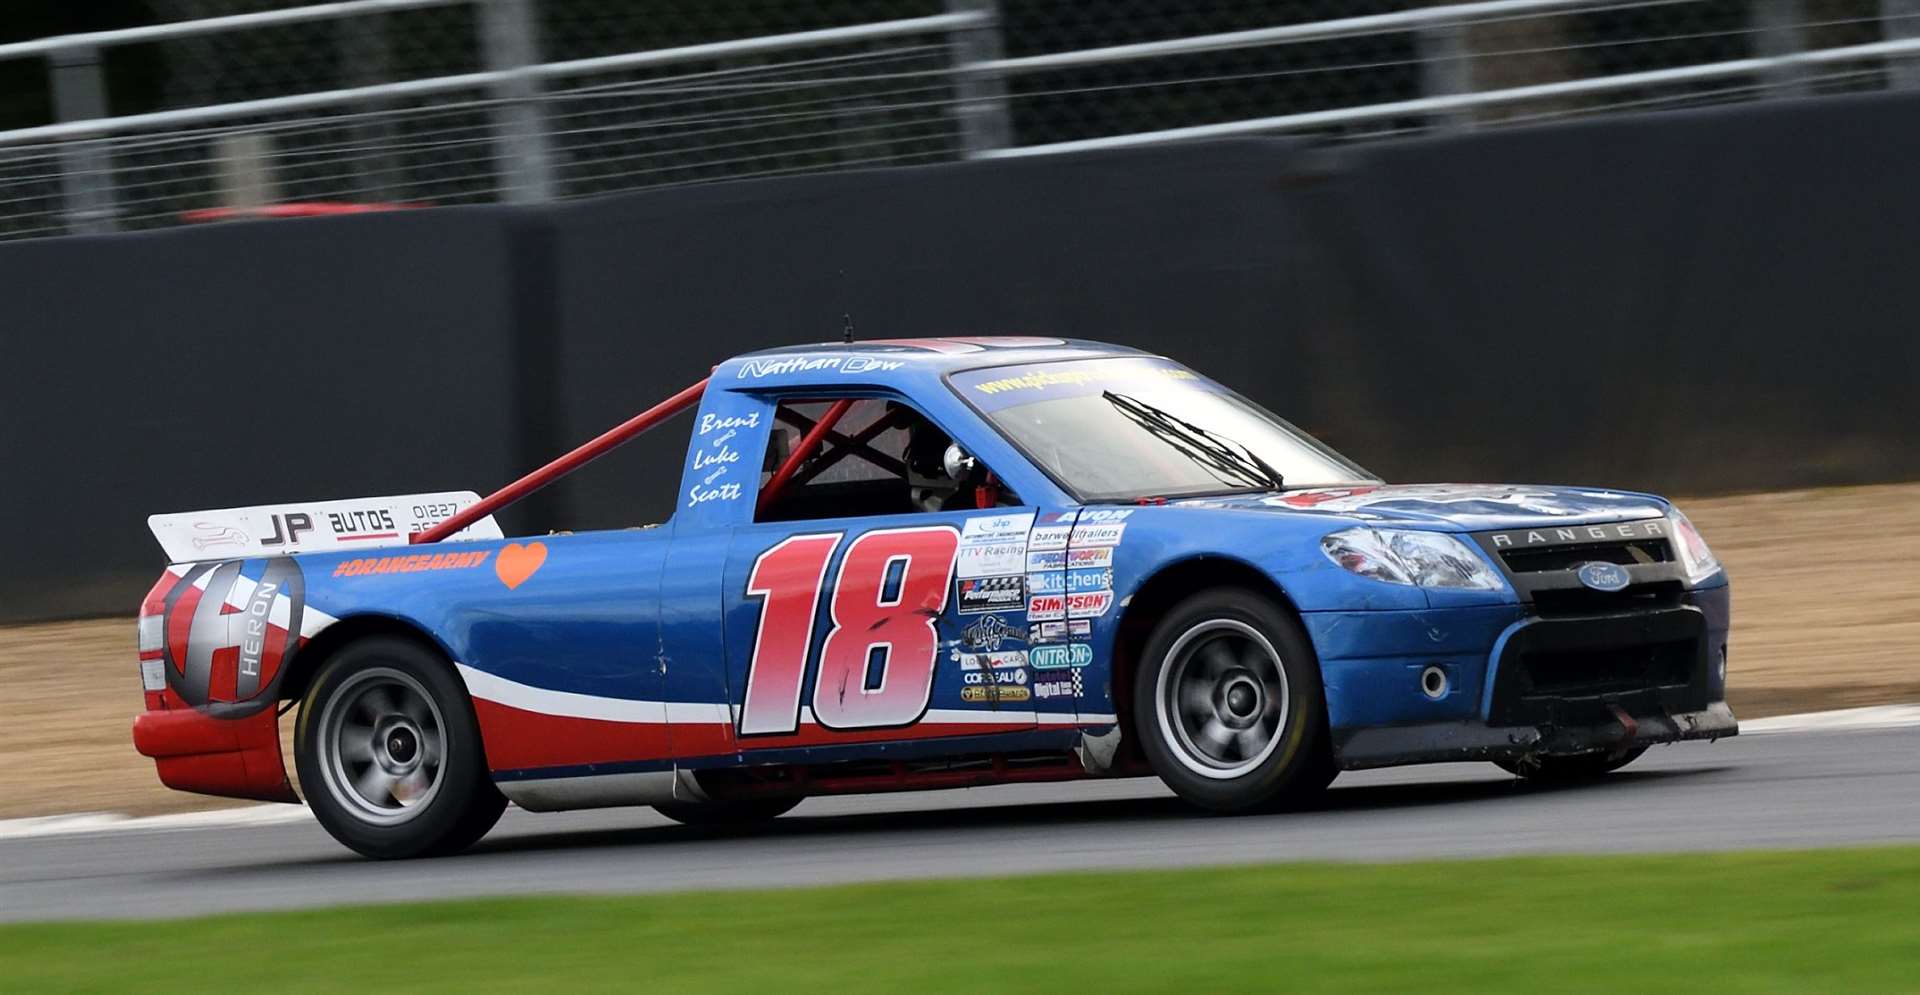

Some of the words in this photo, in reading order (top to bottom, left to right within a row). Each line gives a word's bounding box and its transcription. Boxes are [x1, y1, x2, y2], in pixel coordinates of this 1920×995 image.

[737, 357, 840, 379] Nathan
[699, 412, 760, 435] Brent
[693, 446, 739, 470] Luke
[688, 483, 742, 507] Scott
[412, 502, 457, 519] 01227
[1055, 509, 1134, 523] AVON
[260, 512, 313, 545] JP
[1492, 522, 1663, 548] RANGER
[960, 547, 983, 558] TTV
[984, 546, 1025, 557] Racing
[332, 551, 491, 578] #ORANGEARMY
[1590, 565, 1620, 585] Ford
[1041, 571, 1109, 590] kitchens
[1031, 594, 1104, 612] SIMPSON
[241, 582, 277, 676] HERON
[738, 525, 962, 734] 18
[1036, 648, 1085, 665] NITRON
[964, 671, 1014, 684] COREAU
